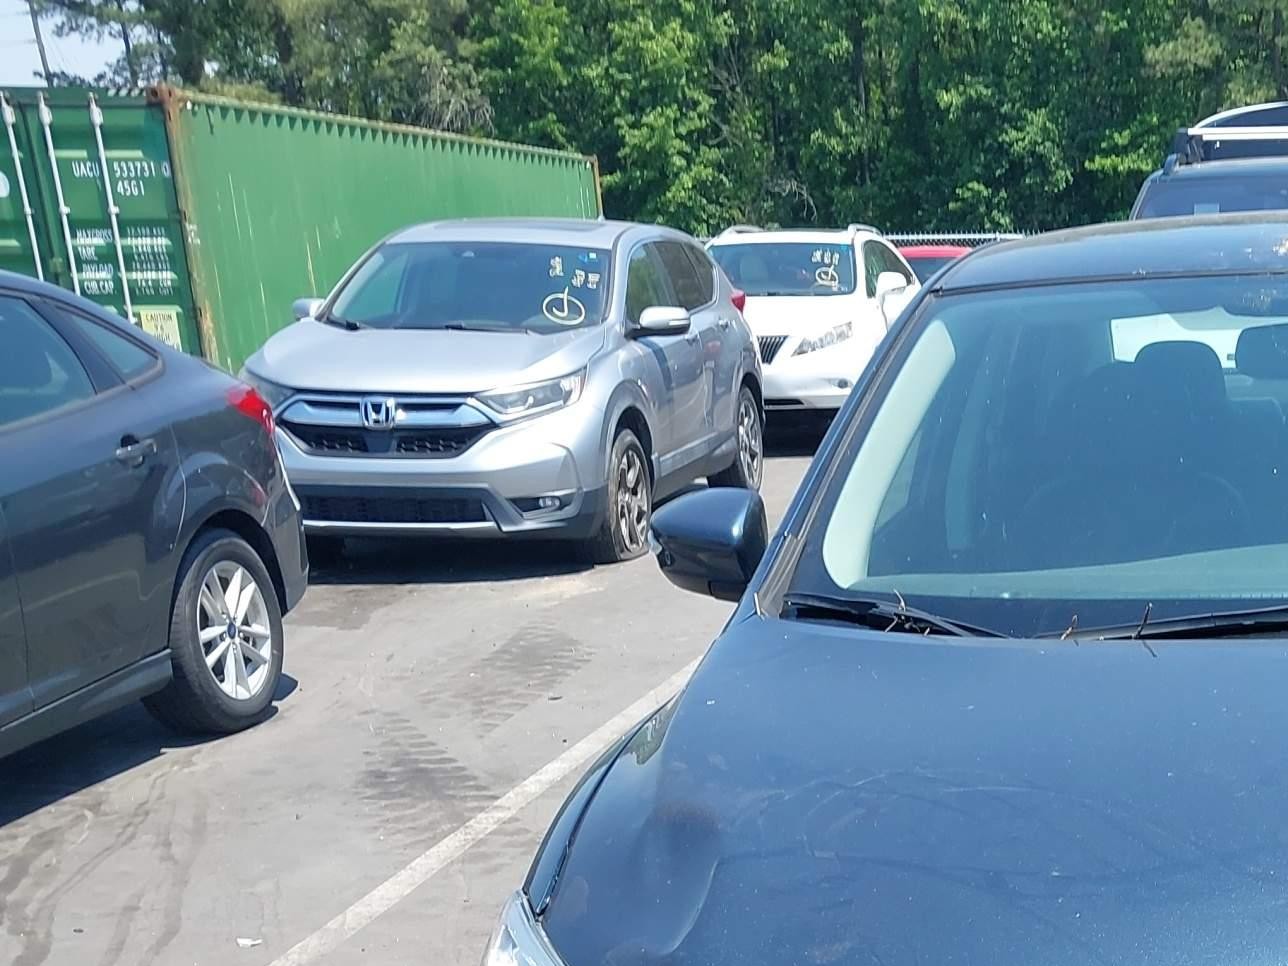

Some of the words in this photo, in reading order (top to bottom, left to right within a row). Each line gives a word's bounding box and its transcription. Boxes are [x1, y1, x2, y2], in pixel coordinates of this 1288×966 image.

[72, 161, 100, 178] UACU
[113, 161, 156, 178] 533731
[117, 180, 145, 196] 45G1
